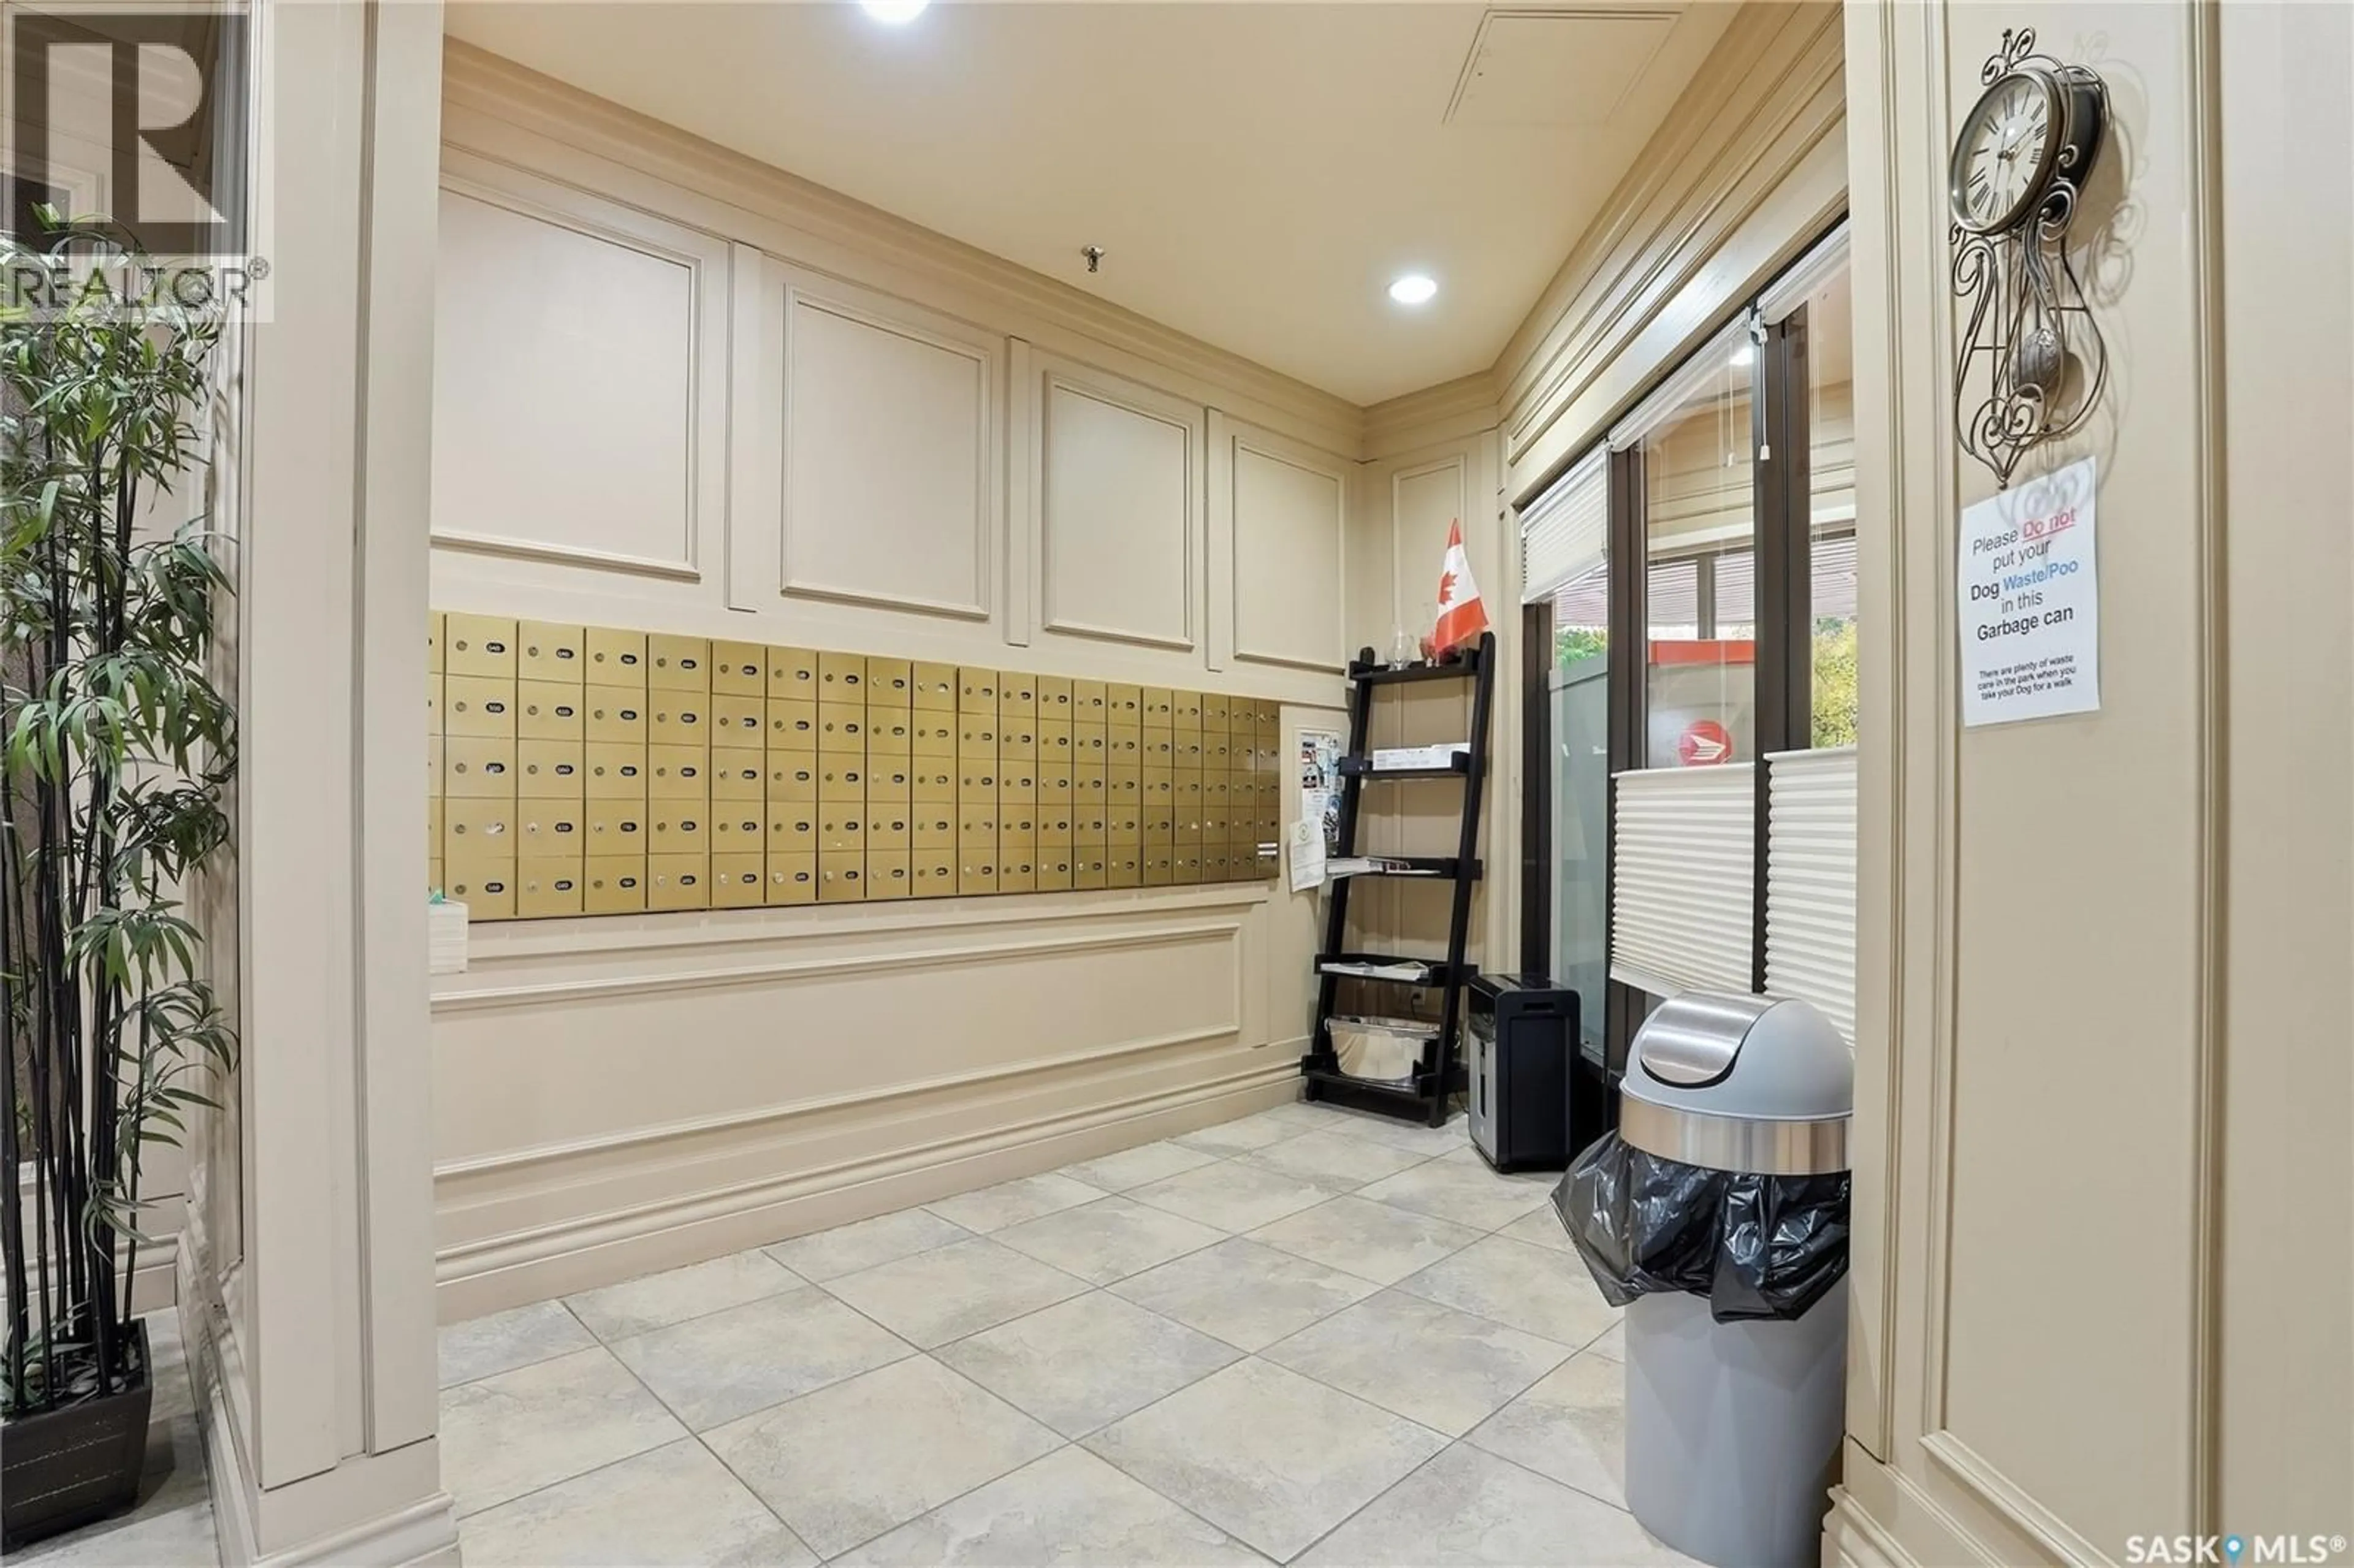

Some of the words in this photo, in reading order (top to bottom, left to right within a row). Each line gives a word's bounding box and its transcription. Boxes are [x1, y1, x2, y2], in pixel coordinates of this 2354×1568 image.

[1972, 529, 2019, 556] Please
[2024, 520, 2045, 538] Do
[2049, 506, 2076, 531] not
[1993, 549, 2014, 574] put
[2019, 539, 2052, 566] your
[1970, 582, 2000, 601] Dog
[2003, 560, 2079, 592] Waste/Poo
[2001, 598, 2014, 614] in
[2017, 590, 2043, 611] this
[1977, 615, 2039, 641] Garbage
[2043, 607, 2074, 626] can
[2000, 667, 2012, 676] are
[2014, 661, 2037, 674] plenty
[2039, 658, 2048, 668] of
[2049, 655, 2074, 665] waste
[2004, 677, 2016, 685] the
[2017, 673, 2035, 683] park
[2036, 669, 2059, 679] when
[2060, 666, 2076, 678] you
[1997, 688, 2015, 699] your
[2016, 685, 2032, 695] Dog
[2033, 682, 2044, 691] for
[2054, 677, 2072, 688] walk
